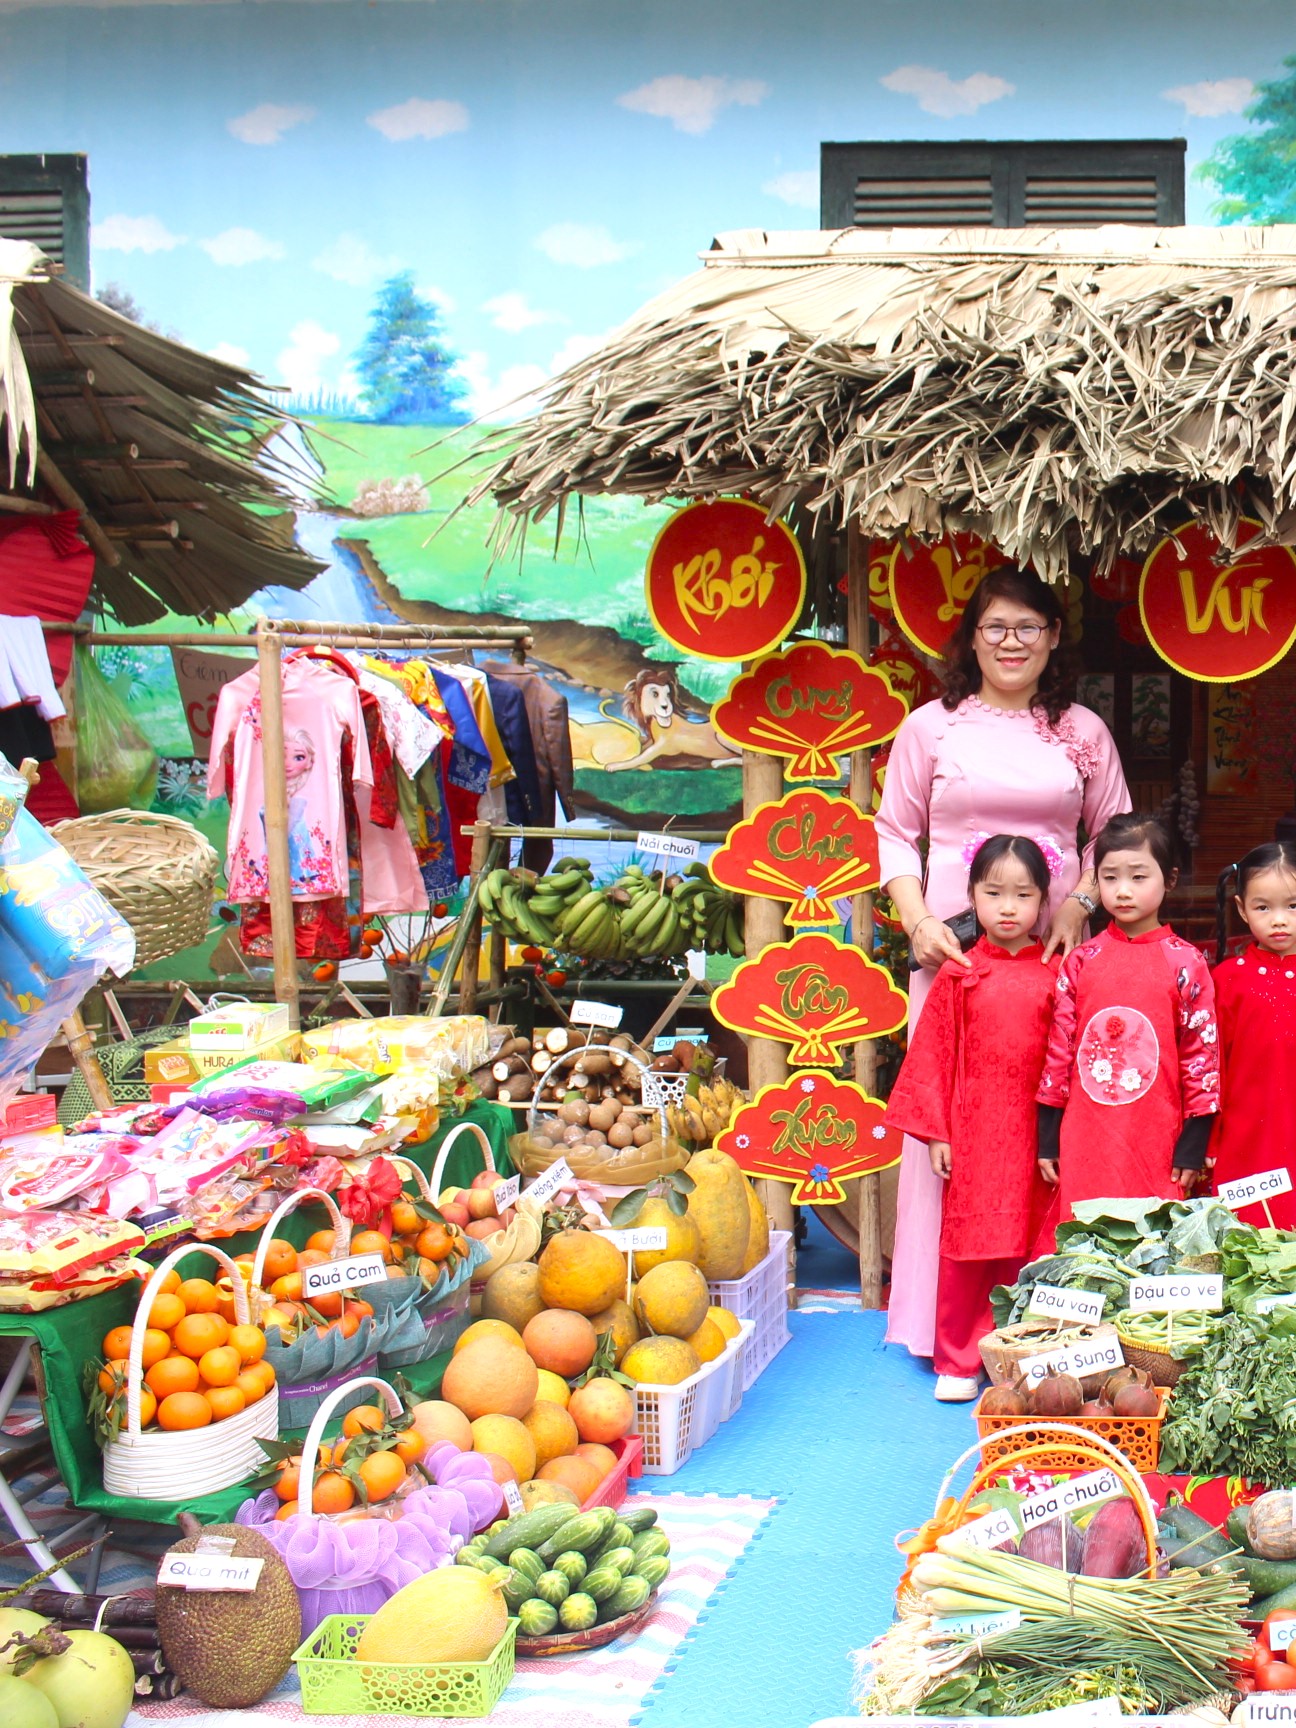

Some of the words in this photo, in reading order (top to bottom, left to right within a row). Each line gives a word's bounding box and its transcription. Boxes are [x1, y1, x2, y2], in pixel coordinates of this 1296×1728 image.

[1178, 563, 1272, 636] Vui
[765, 673, 854, 722] Cung
[663, 842, 695, 856] chuối
[767, 811, 854, 865] Chúc
[775, 963, 849, 1020] Tân
[203, 1056, 234, 1067] HURA
[769, 1096, 857, 1159] Xuân
[1226, 1182, 1255, 1201] Bắp
[1259, 1173, 1283, 1192] cải
[309, 1267, 341, 1287] Quả
[345, 1264, 382, 1281] Cam
[1134, 1285, 1164, 1302] Đậu
[1197, 1285, 1217, 1296] ve
[1074, 1348, 1116, 1369] Sung
[1022, 1498, 1059, 1524] Hoa
[1064, 1471, 1118, 1507] chuối
